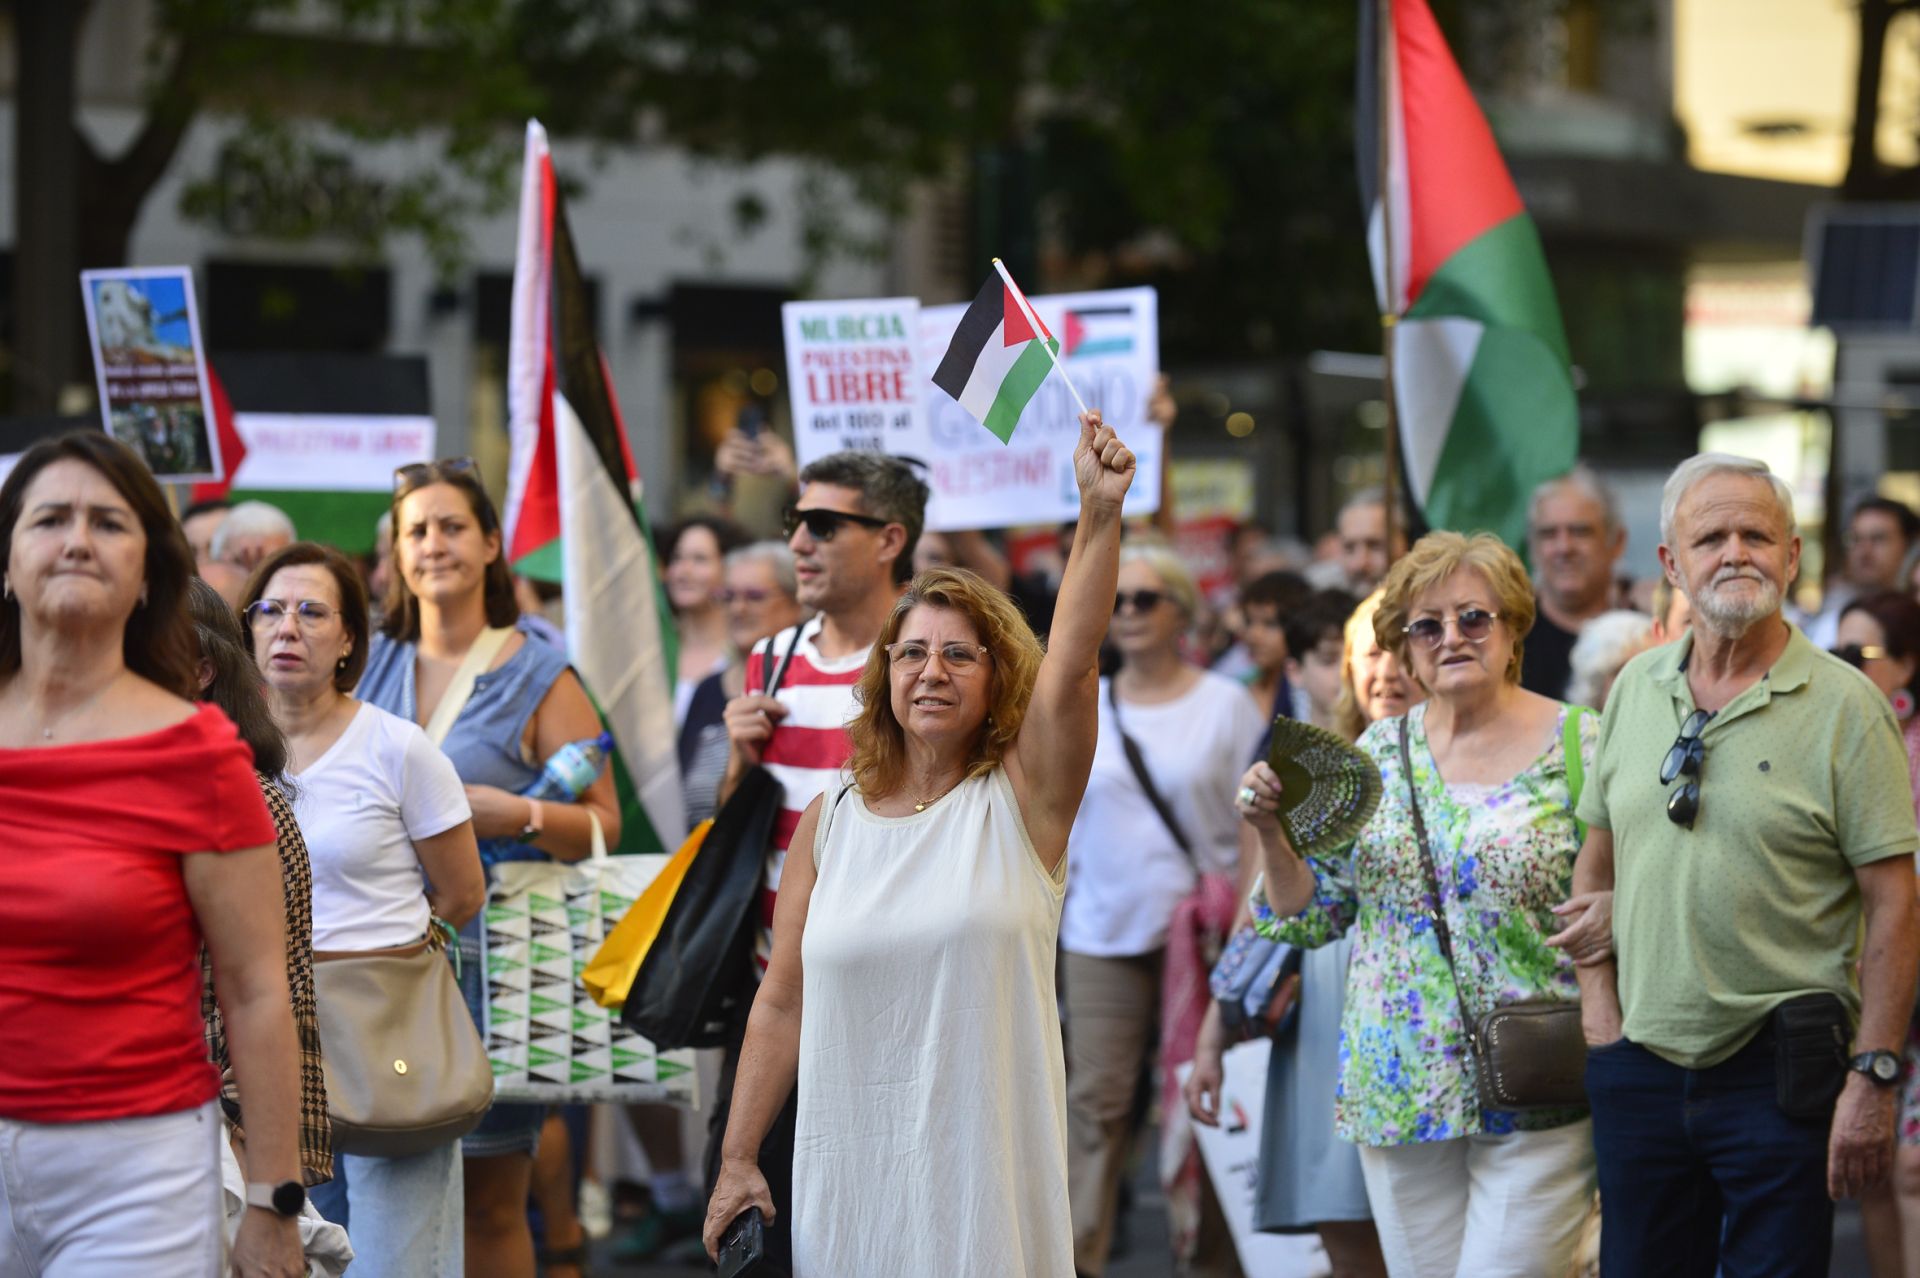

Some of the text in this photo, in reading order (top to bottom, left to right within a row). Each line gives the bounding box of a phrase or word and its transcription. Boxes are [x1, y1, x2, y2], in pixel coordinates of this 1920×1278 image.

[800, 314, 907, 342] MURCIA
[801, 347, 913, 368] PALESTINA
[807, 371, 916, 406] LIBRE
